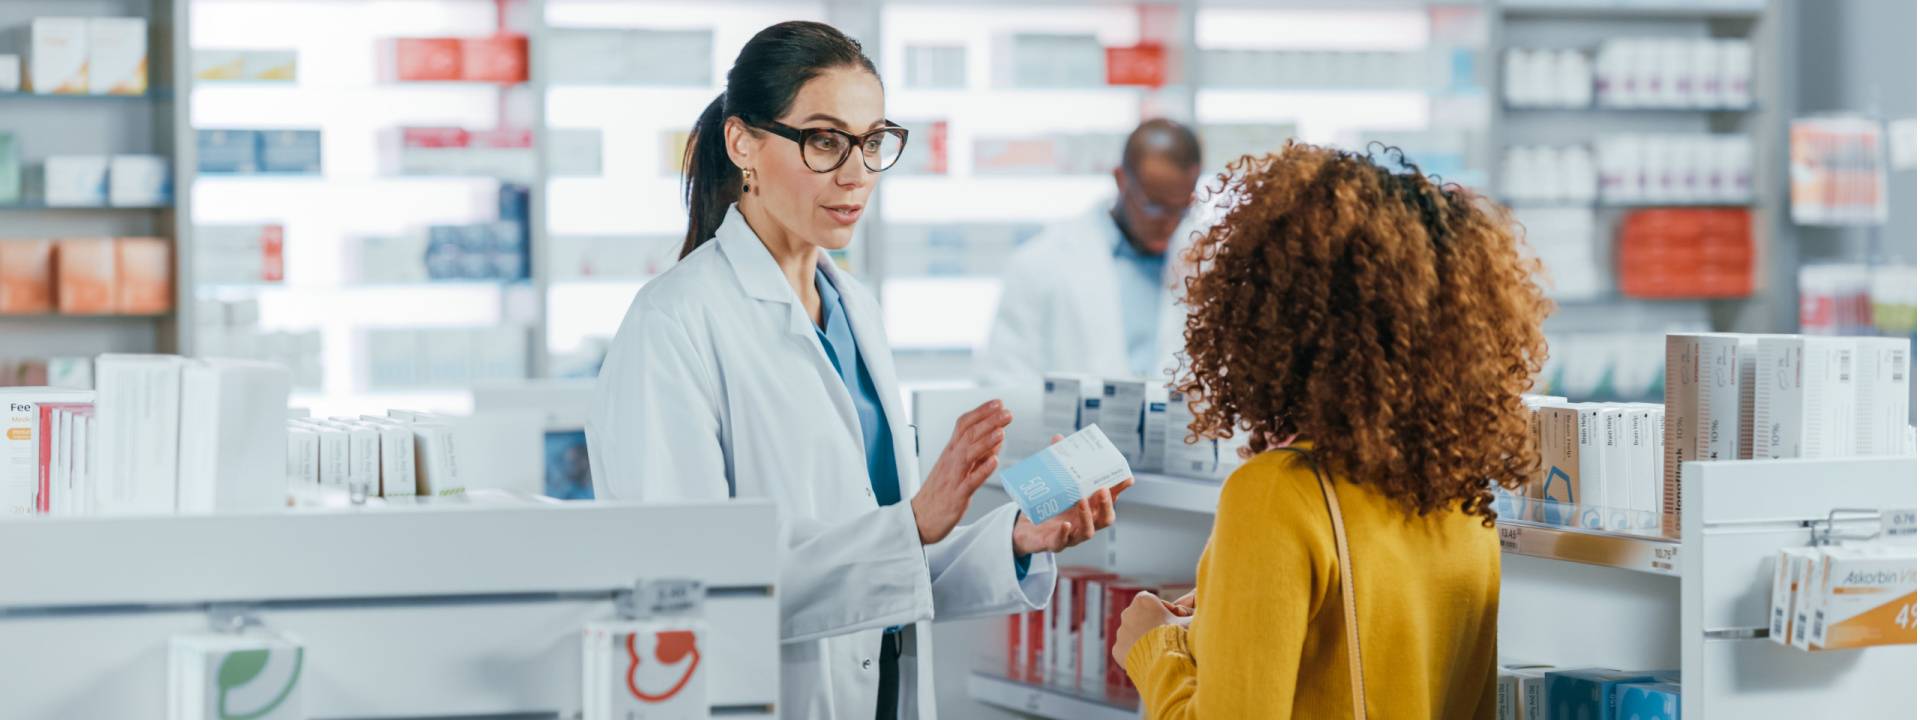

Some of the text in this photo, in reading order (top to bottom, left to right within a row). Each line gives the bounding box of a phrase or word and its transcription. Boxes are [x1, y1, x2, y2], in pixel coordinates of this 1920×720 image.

[10, 402, 31, 412] Fee
[1711, 418, 1719, 442] 10%
[1019, 476, 1050, 501] 500
[1036, 499, 1059, 519] 500
[1843, 570, 1897, 585] Askorbin
